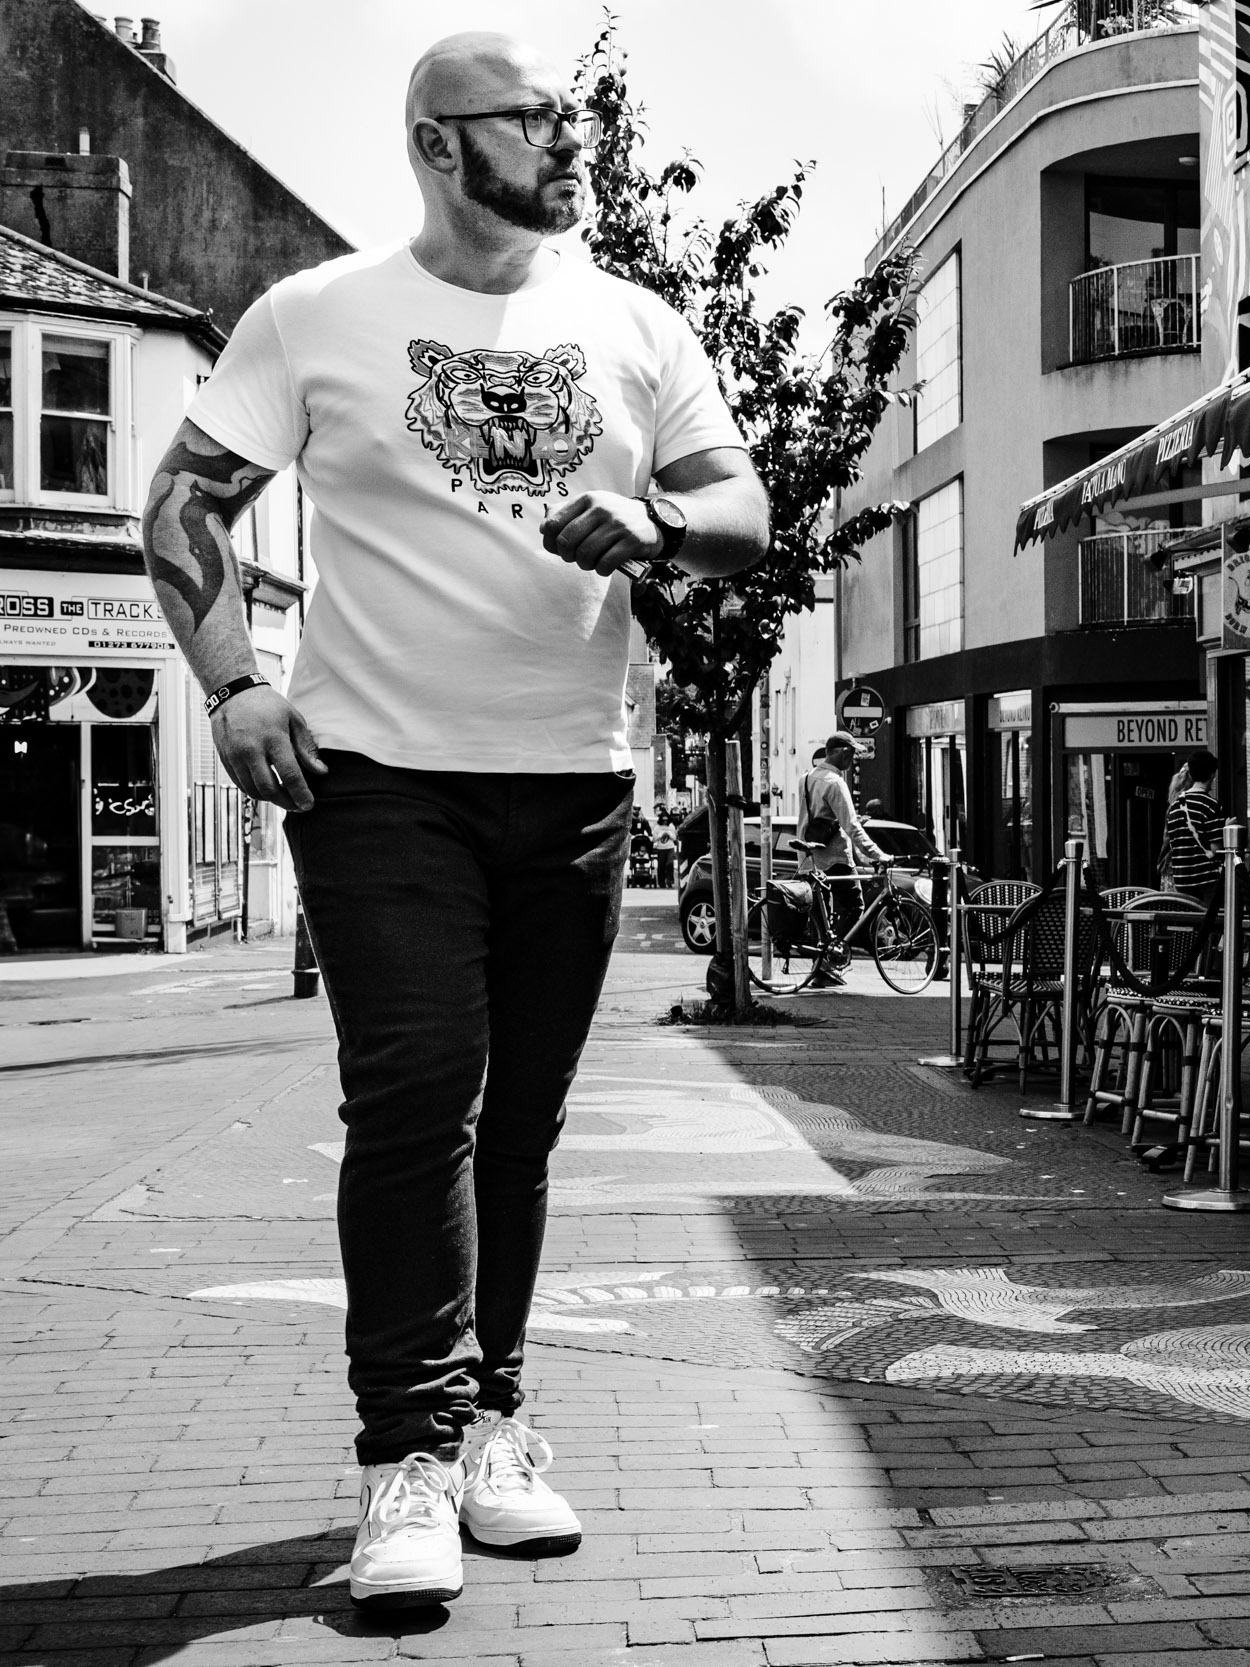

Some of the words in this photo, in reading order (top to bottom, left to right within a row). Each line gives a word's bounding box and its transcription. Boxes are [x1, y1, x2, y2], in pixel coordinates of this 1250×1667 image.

[1155, 419, 1195, 465] PIZZERIA
[61, 603, 83, 614] THE
[102, 629, 110, 637] &
[1117, 718, 1179, 743] BEYOND
